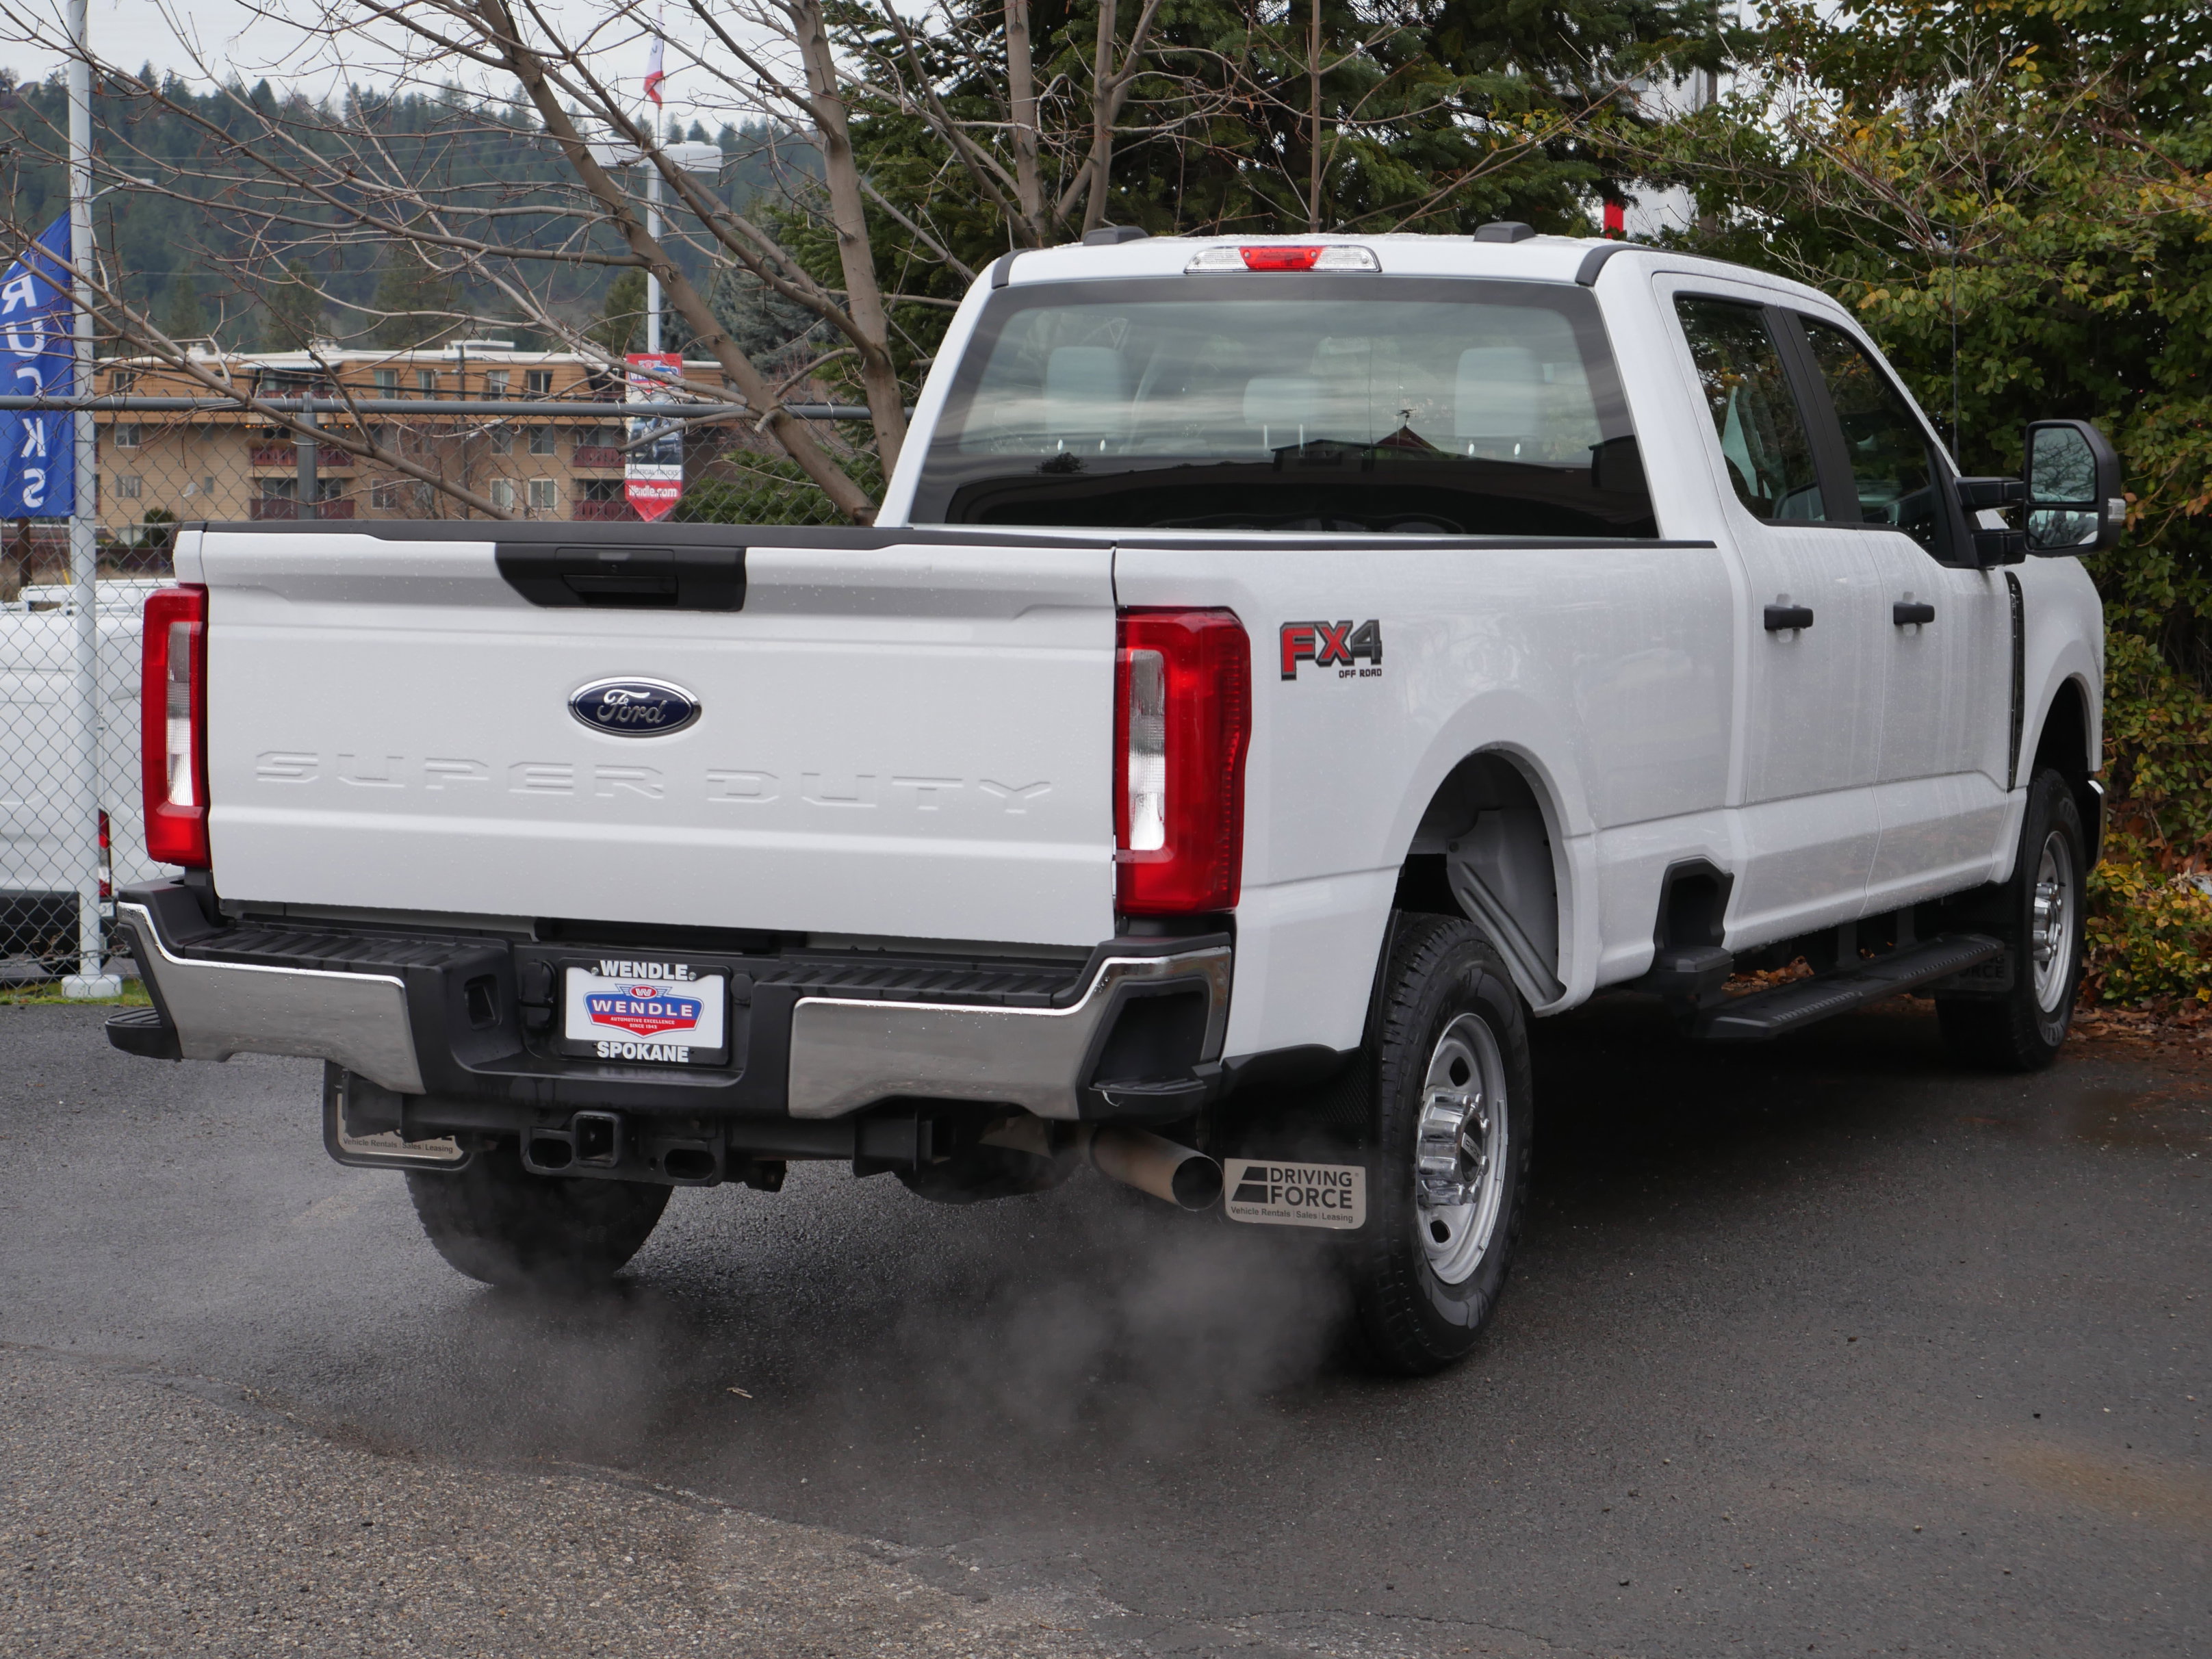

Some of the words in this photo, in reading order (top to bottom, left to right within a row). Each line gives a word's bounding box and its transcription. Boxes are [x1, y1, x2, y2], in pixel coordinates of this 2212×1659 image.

[628, 485, 678, 498] Wendle.com
[1280, 619, 1382, 681] FX4
[1339, 669, 1356, 678] OFF
[1359, 668, 1382, 678] ROAD
[596, 689, 668, 724] Ford
[255, 750, 665, 799] SUPER
[706, 768, 1052, 814] DUTY
[600, 960, 689, 981] WENDLE
[592, 999, 693, 1017] WENDLE
[596, 1041, 689, 1063] SPOKANE
[342, 1137, 369, 1146] Vehicle
[370, 1140, 398, 1148] Rentals
[425, 1144, 453, 1154] Leasing
[1270, 1167, 1352, 1187] DRIVING
[1270, 1185, 1353, 1209] FORCE
[1231, 1206, 1259, 1216] Vehicle
[1261, 1208, 1291, 1218] Rentals
[1296, 1211, 1317, 1220] Sales
[1322, 1212, 1354, 1224] Leasing
